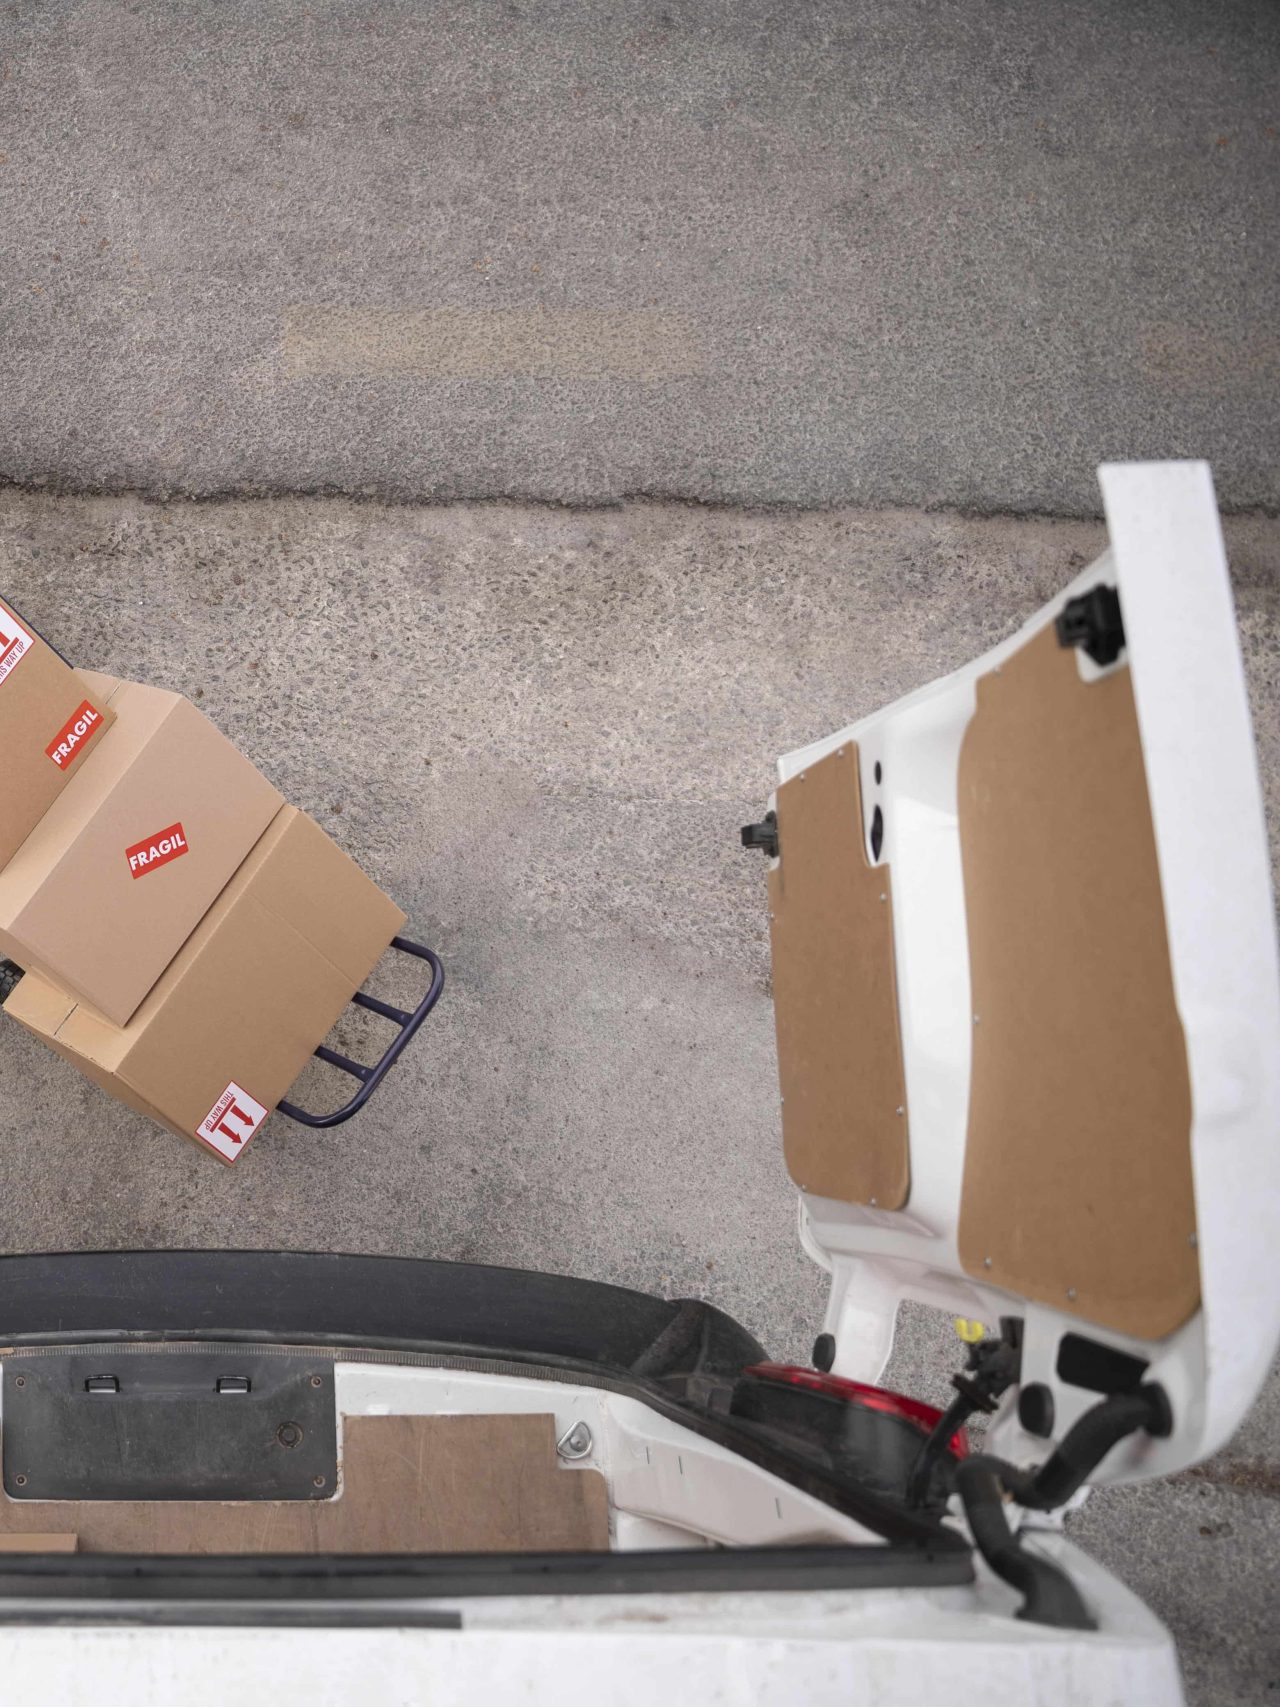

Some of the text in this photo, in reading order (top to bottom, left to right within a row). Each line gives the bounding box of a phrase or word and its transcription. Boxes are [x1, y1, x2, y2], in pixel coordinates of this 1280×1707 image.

[4, 650, 18, 668] WAY
[15, 641, 25, 653] UP
[51, 710, 98, 765] FRAGIL
[129, 833, 186, 871] FRAGIL
[204, 1091, 234, 1131] THIS WAY UP
